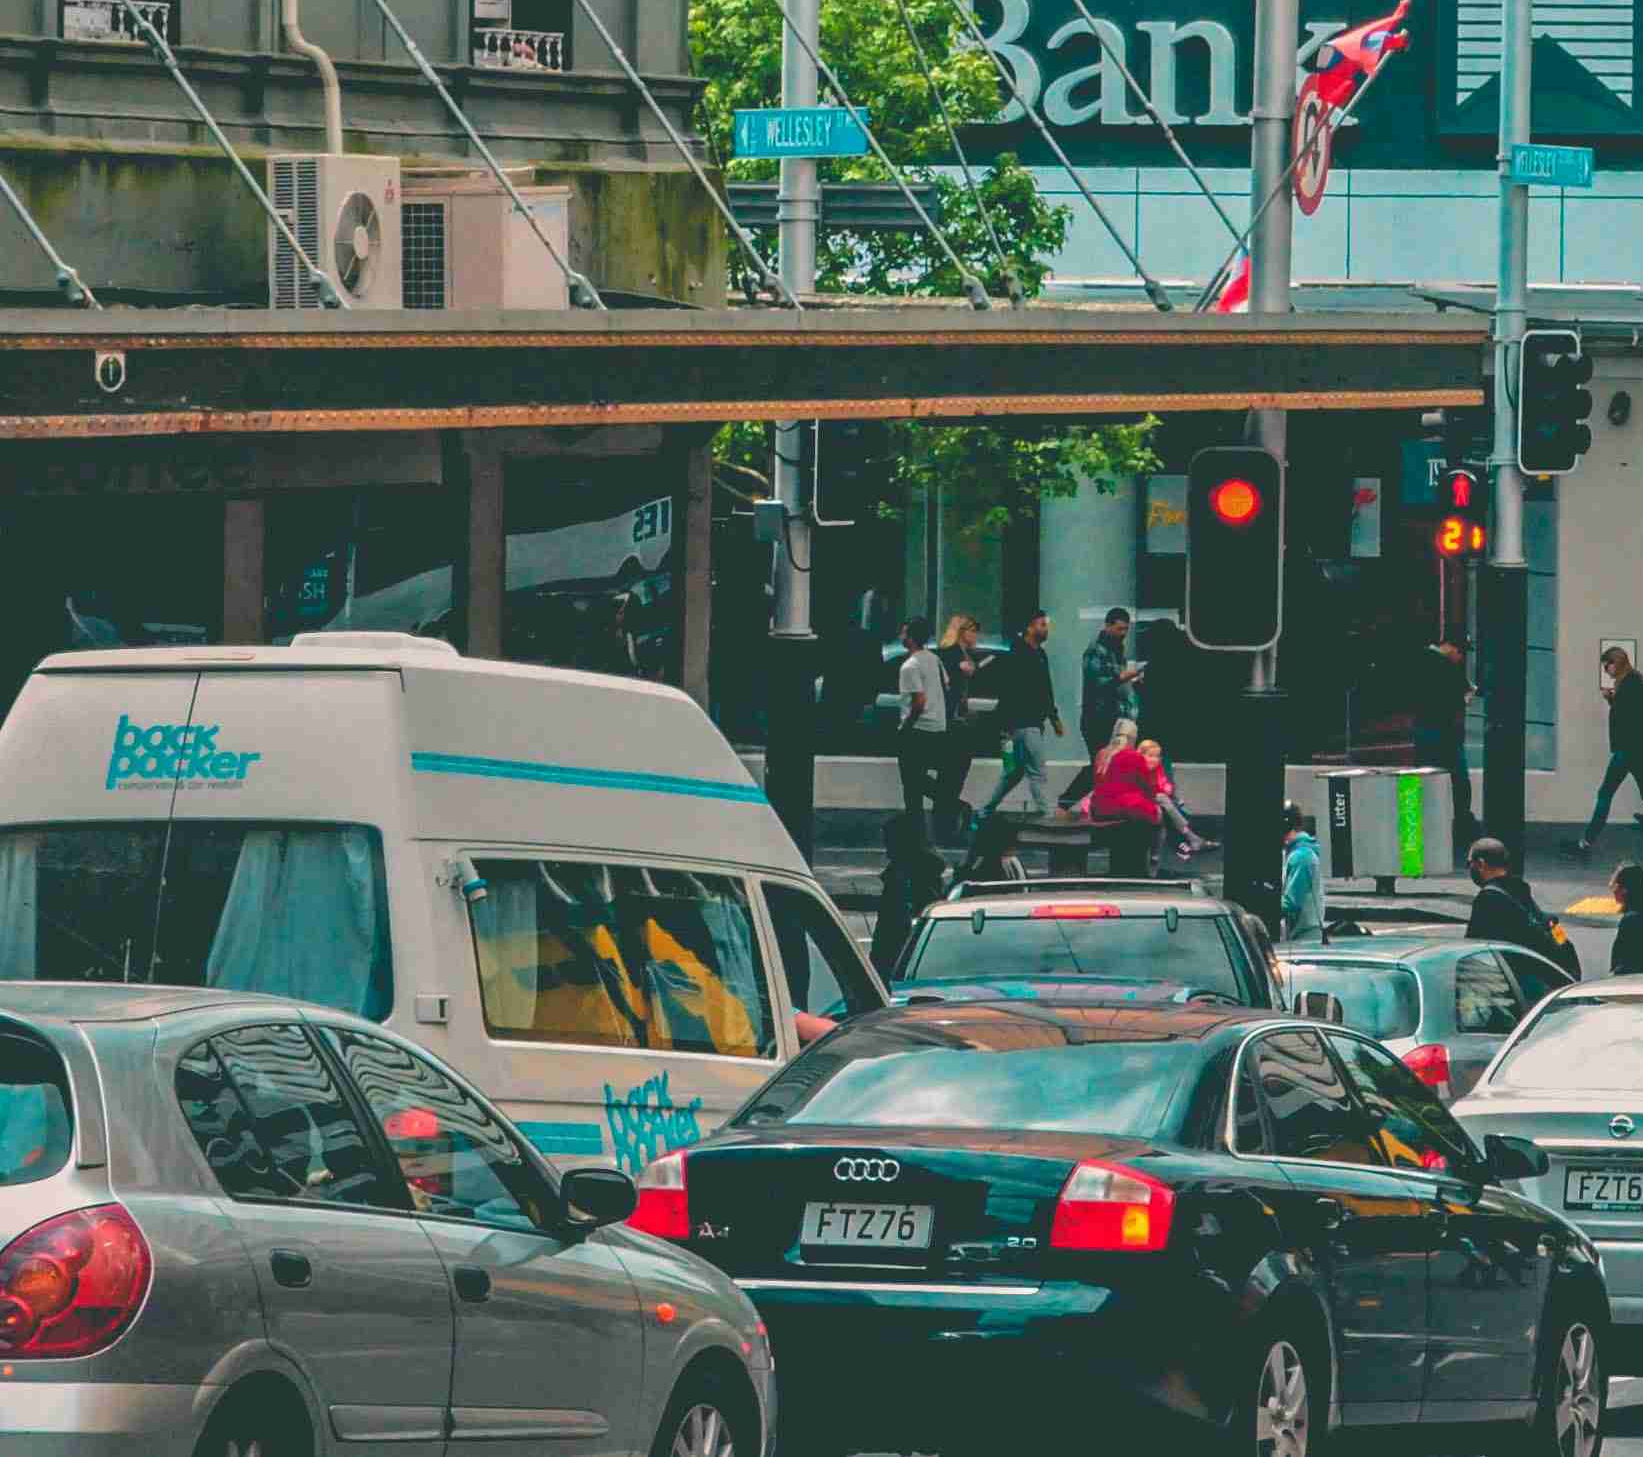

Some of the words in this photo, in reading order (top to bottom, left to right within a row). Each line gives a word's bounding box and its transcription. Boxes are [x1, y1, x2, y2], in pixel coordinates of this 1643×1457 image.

[766, 114, 832, 147] WELLESLEY
[113, 714, 220, 753] back
[106, 750, 261, 790] packer
[1335, 793, 1346, 827] Litter
[815, 1208, 916, 1242] FTZ76
